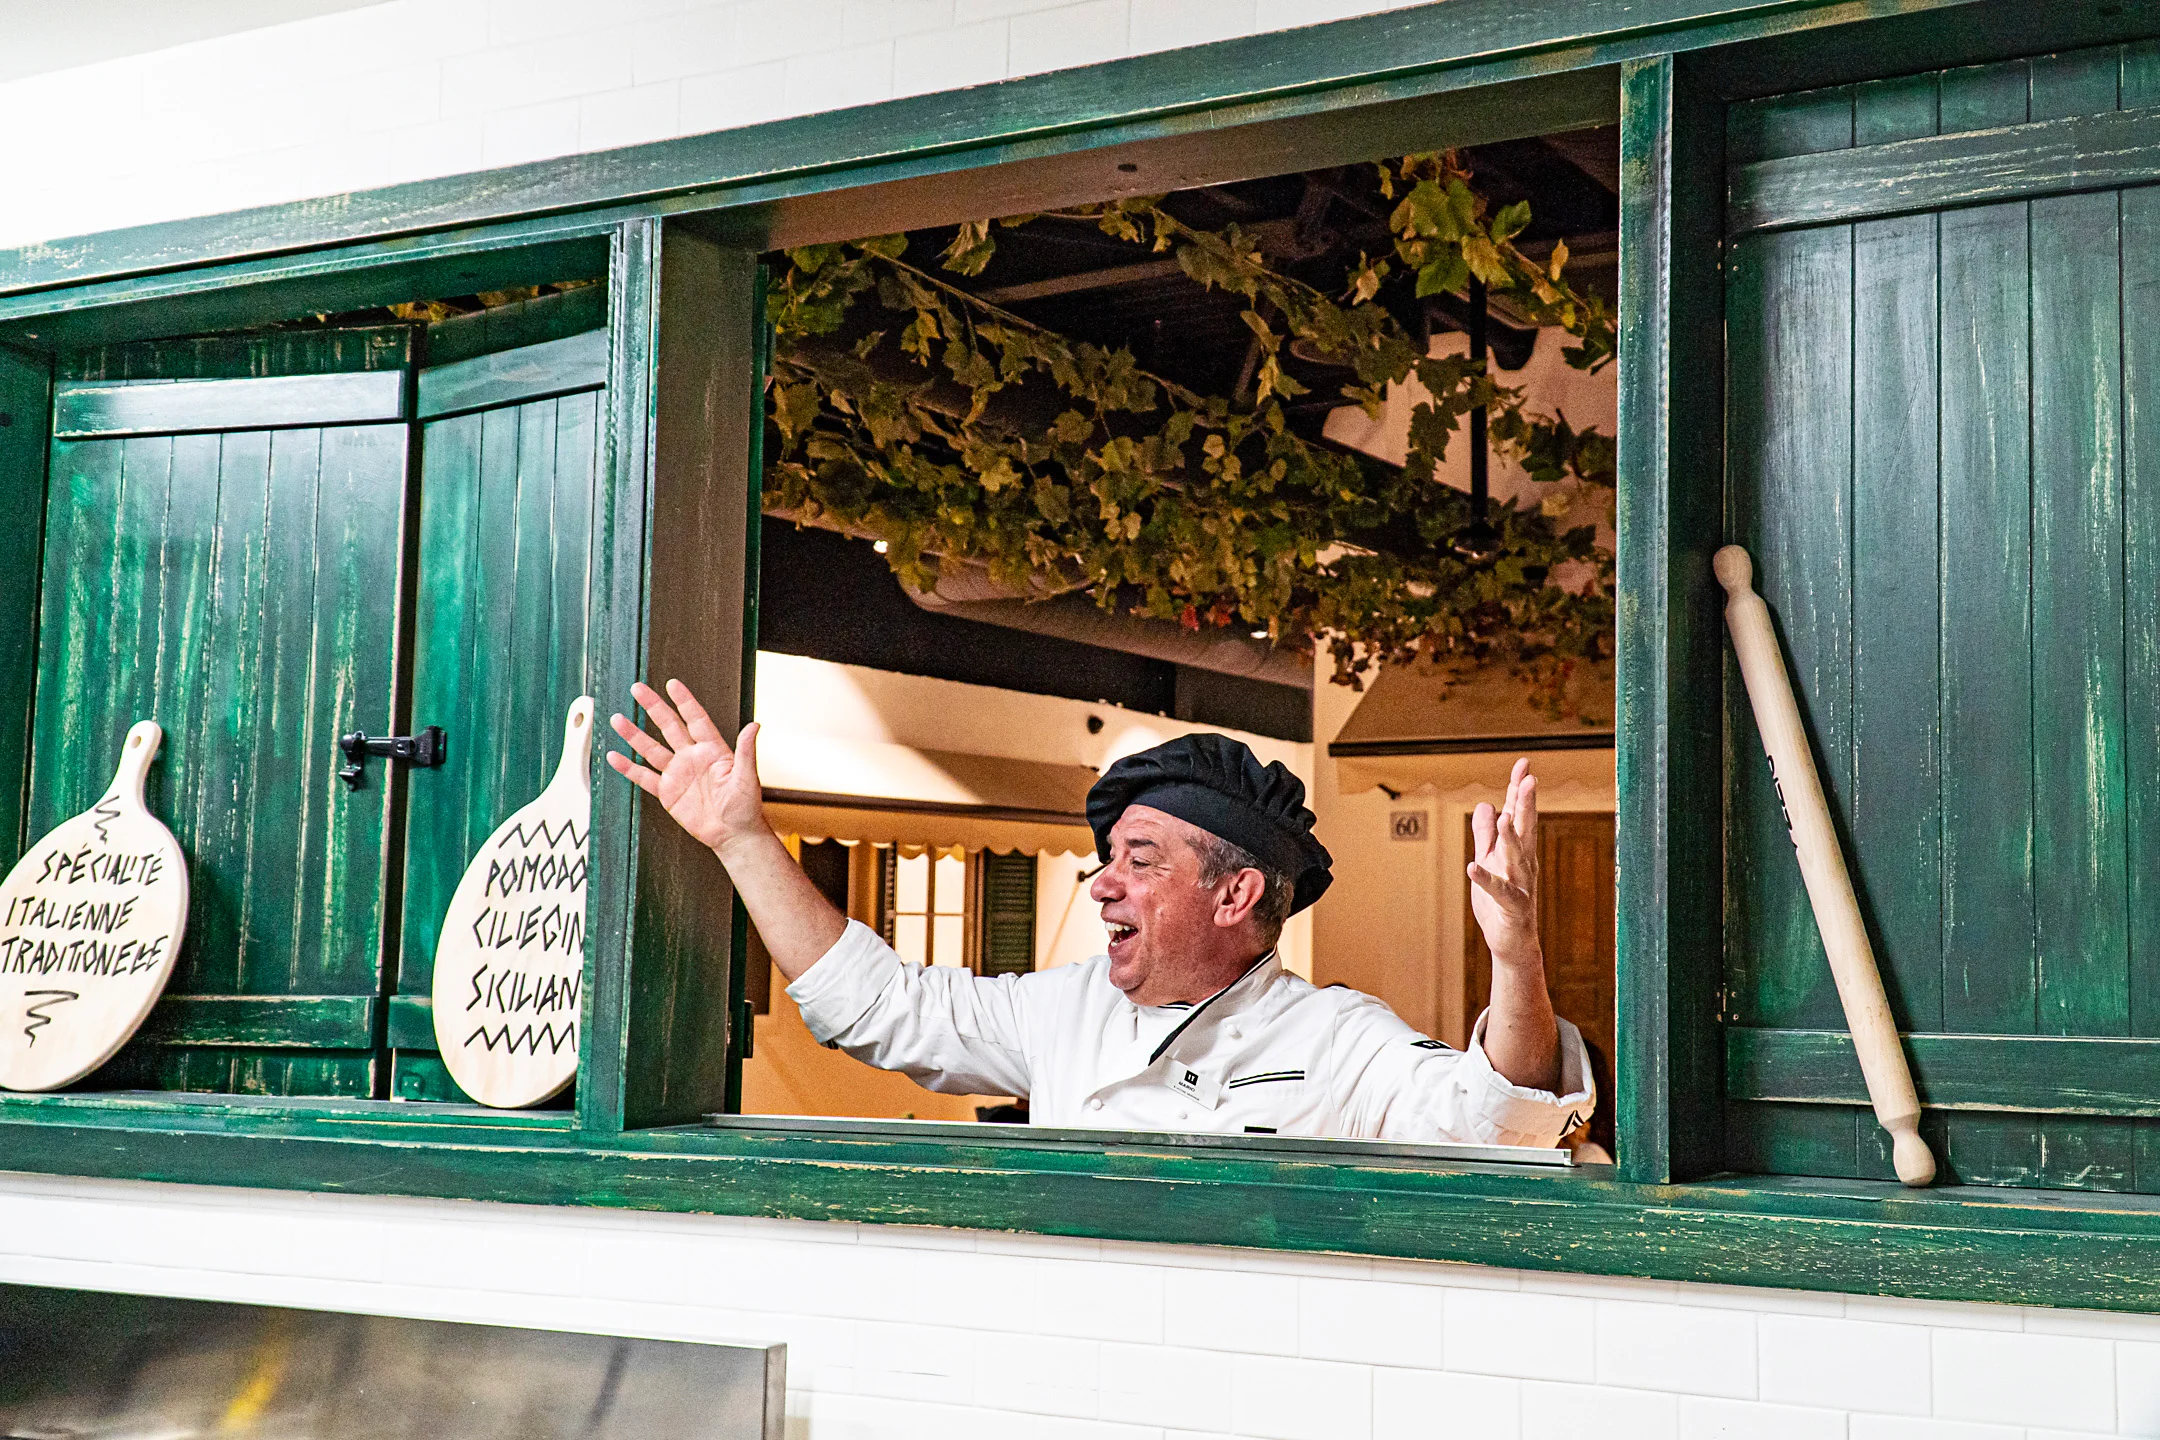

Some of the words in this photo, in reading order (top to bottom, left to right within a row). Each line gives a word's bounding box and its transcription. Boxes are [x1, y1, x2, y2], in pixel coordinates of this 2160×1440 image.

[1396, 816, 1419, 836] 60
[36, 842, 165, 886] SPÉCIALITÉ
[5, 895, 140, 934] ITALIENNE
[466, 963, 583, 1016] SICILIAN
